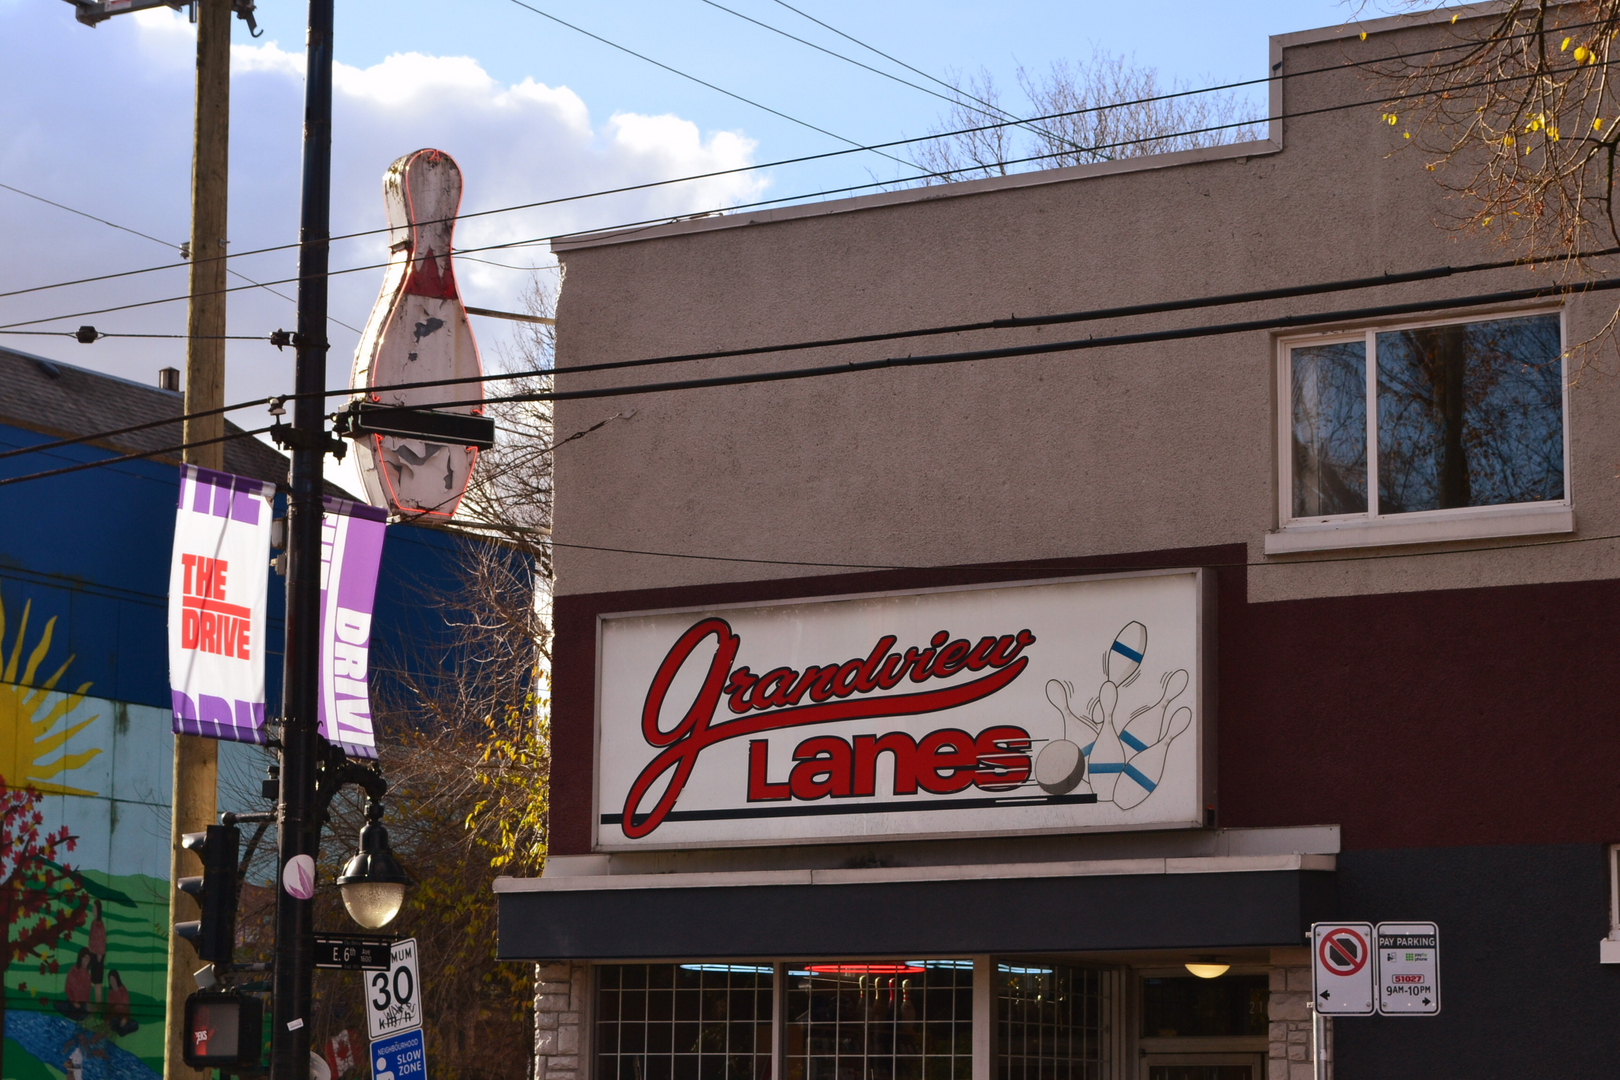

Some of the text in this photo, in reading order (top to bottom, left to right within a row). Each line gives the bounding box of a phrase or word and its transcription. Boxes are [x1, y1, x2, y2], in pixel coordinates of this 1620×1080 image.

[181, 553, 228, 601] THE
[181, 607, 251, 661] DRIVE
[746, 725, 1034, 803] Lanes
[1379, 937, 1435, 946] PAY PARKING
[333, 947, 341, 962] E.
[343, 947, 357, 962] 6th
[1394, 975, 1422, 983] 51027
[371, 965, 414, 1012] 30
[377, 1038, 419, 1056] NEIGHBOURHOOD
[396, 1049, 422, 1065] SLOW
[398, 1061, 422, 1076] ZONE
